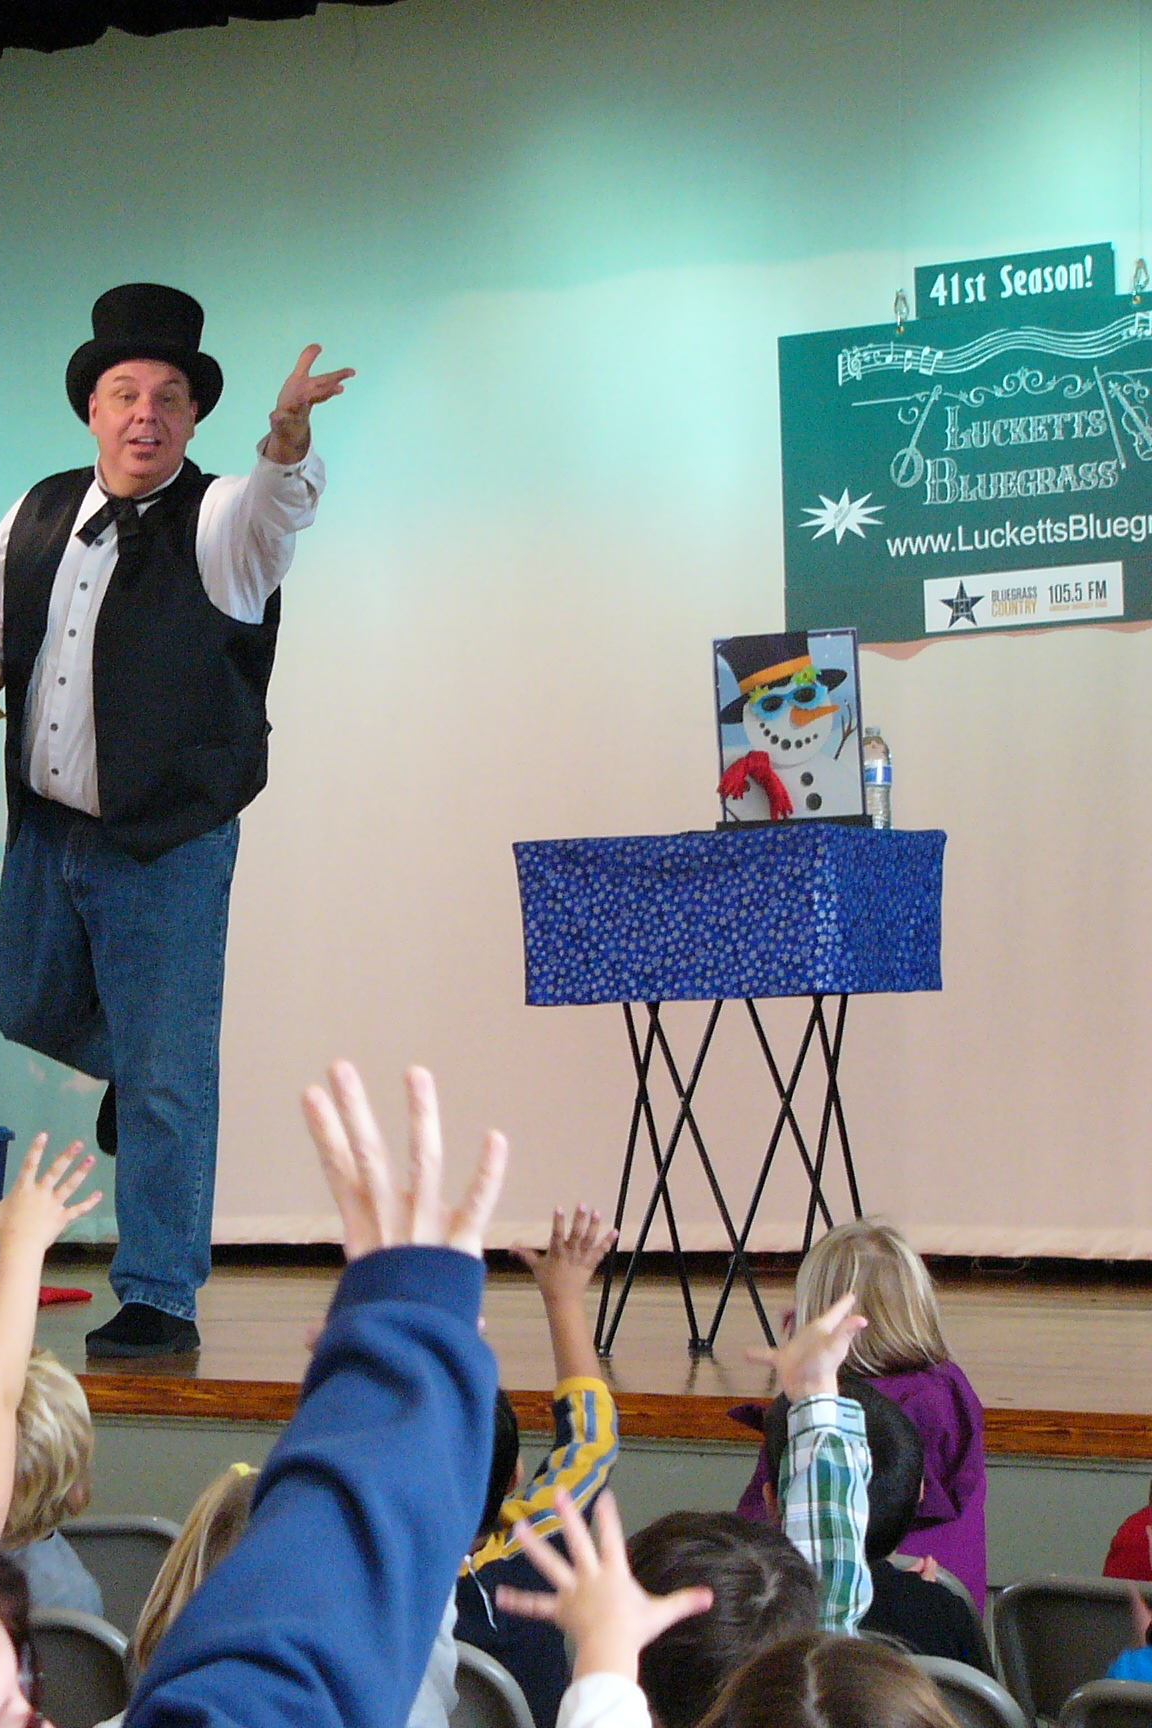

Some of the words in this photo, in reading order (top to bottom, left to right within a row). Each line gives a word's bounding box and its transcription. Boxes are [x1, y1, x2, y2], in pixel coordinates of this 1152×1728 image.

[929, 272, 986, 306] 41st
[999, 254, 1093, 298] Season!
[991, 586, 1038, 602] BLUEGRASS
[1048, 582, 1083, 604] 105.5
[1088, 580, 1107, 600] FM
[991, 599, 1038, 617] COUNTRY
